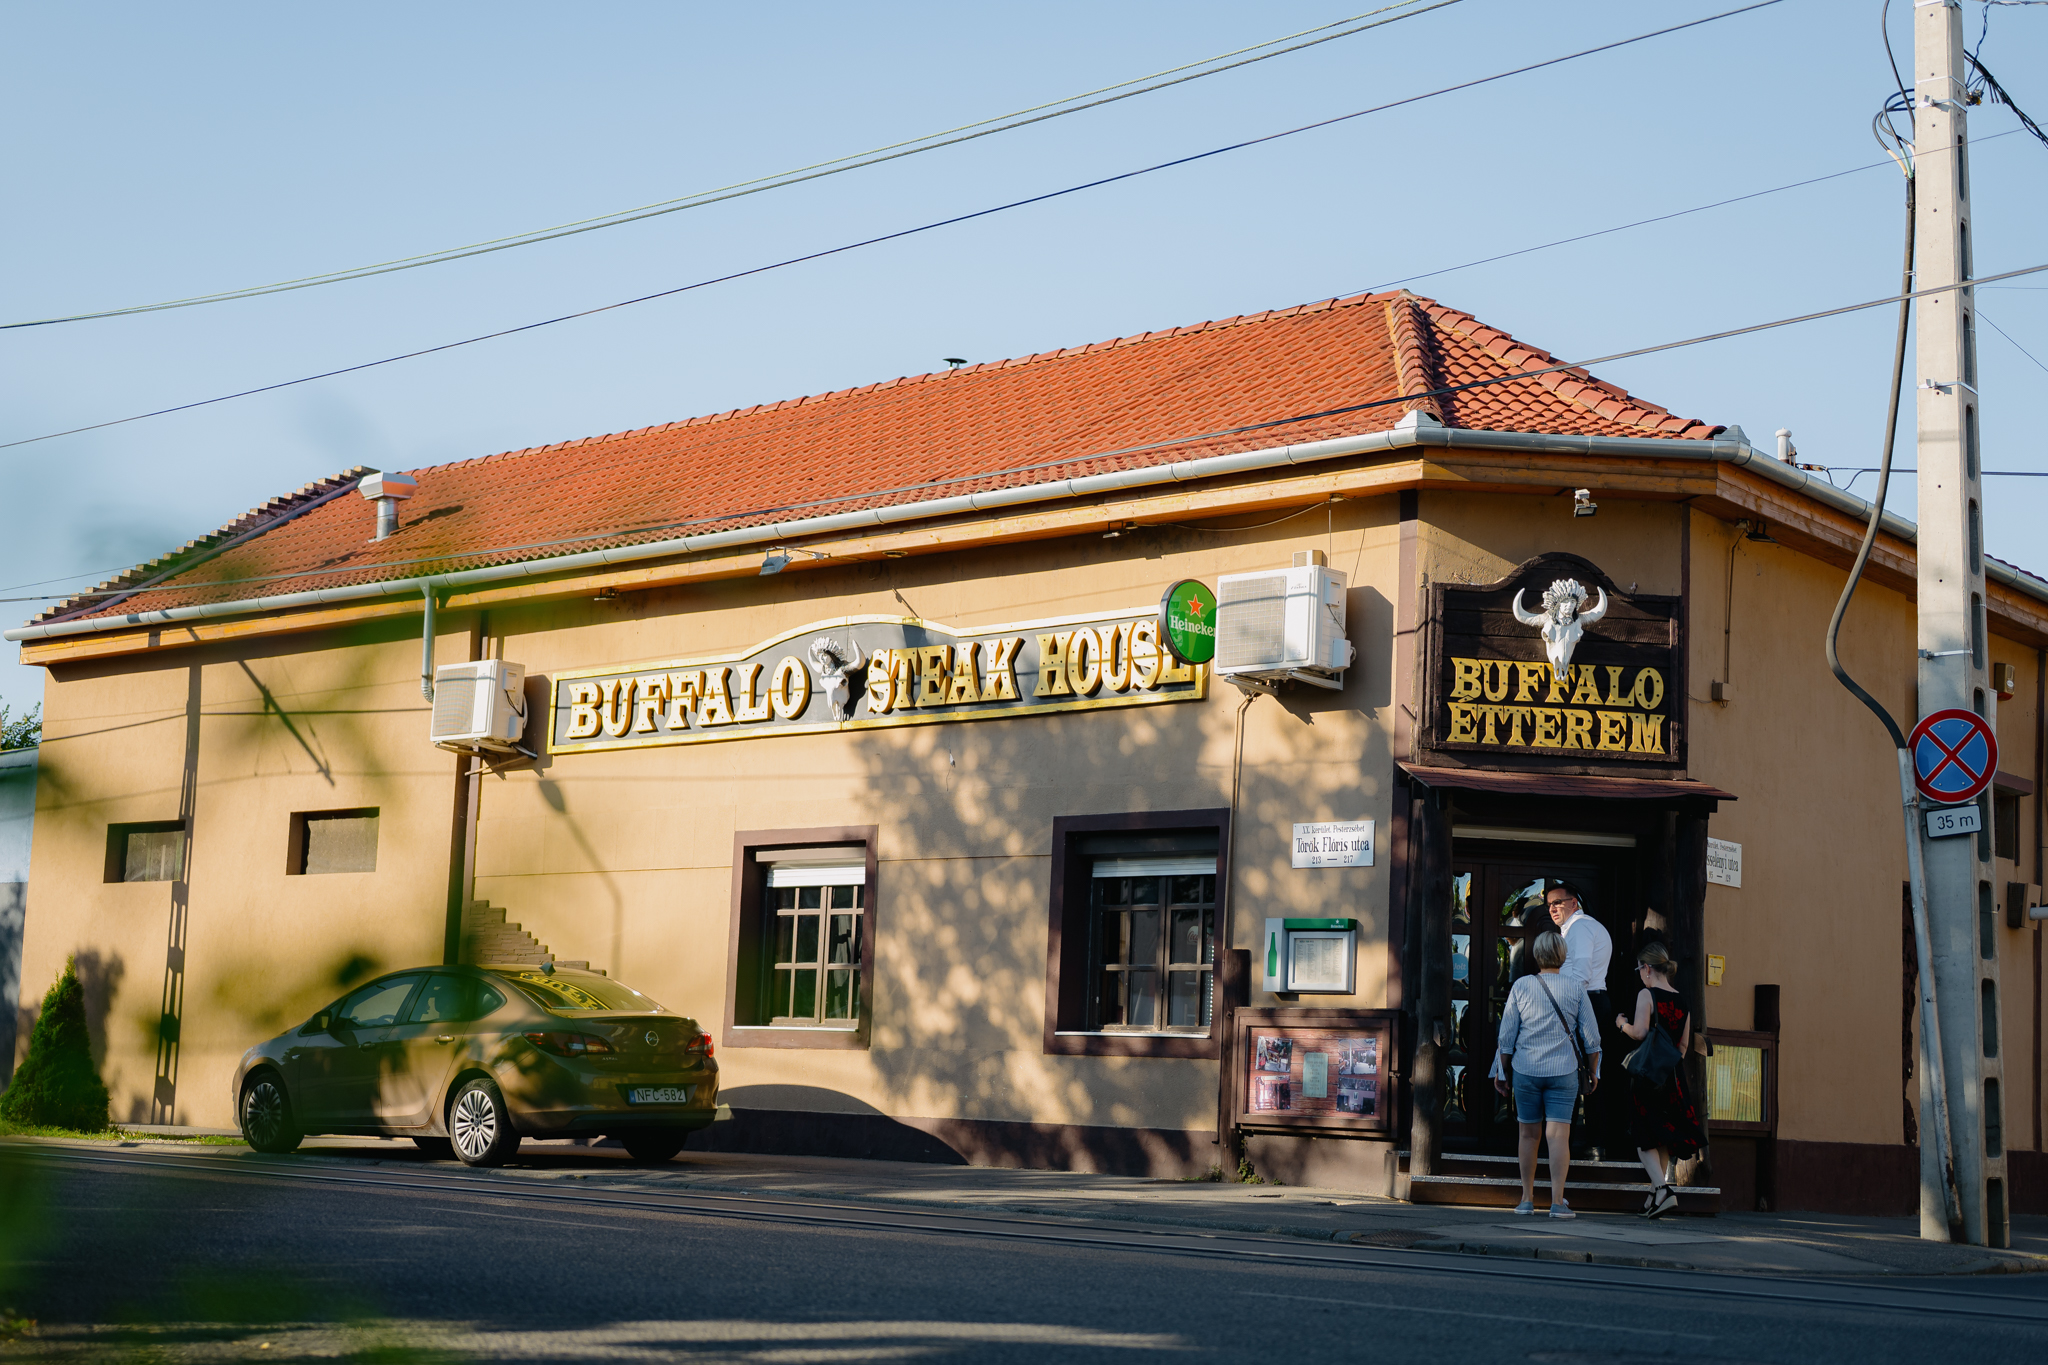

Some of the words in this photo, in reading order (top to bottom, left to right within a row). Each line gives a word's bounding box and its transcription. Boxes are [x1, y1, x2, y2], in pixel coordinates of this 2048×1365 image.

[564, 655, 811, 739] BUFFALO
[867, 635, 1025, 713] STEAK
[1449, 656, 1665, 710] BUFFALO
[1446, 694, 1666, 754] ÉTTEREM
[1937, 815, 1954, 830] 35
[1959, 815, 1974, 827] m
[1296, 836, 1320, 853] Török
[1322, 836, 1348, 853] Flóris
[1351, 835, 1370, 851] utca
[1311, 856, 1322, 865] 213
[1343, 855, 1353, 864] 217
[1707, 851, 1727, 873] sselényi
[1728, 855, 1739, 872] utca
[636, 1089, 684, 1101] NFC-582
